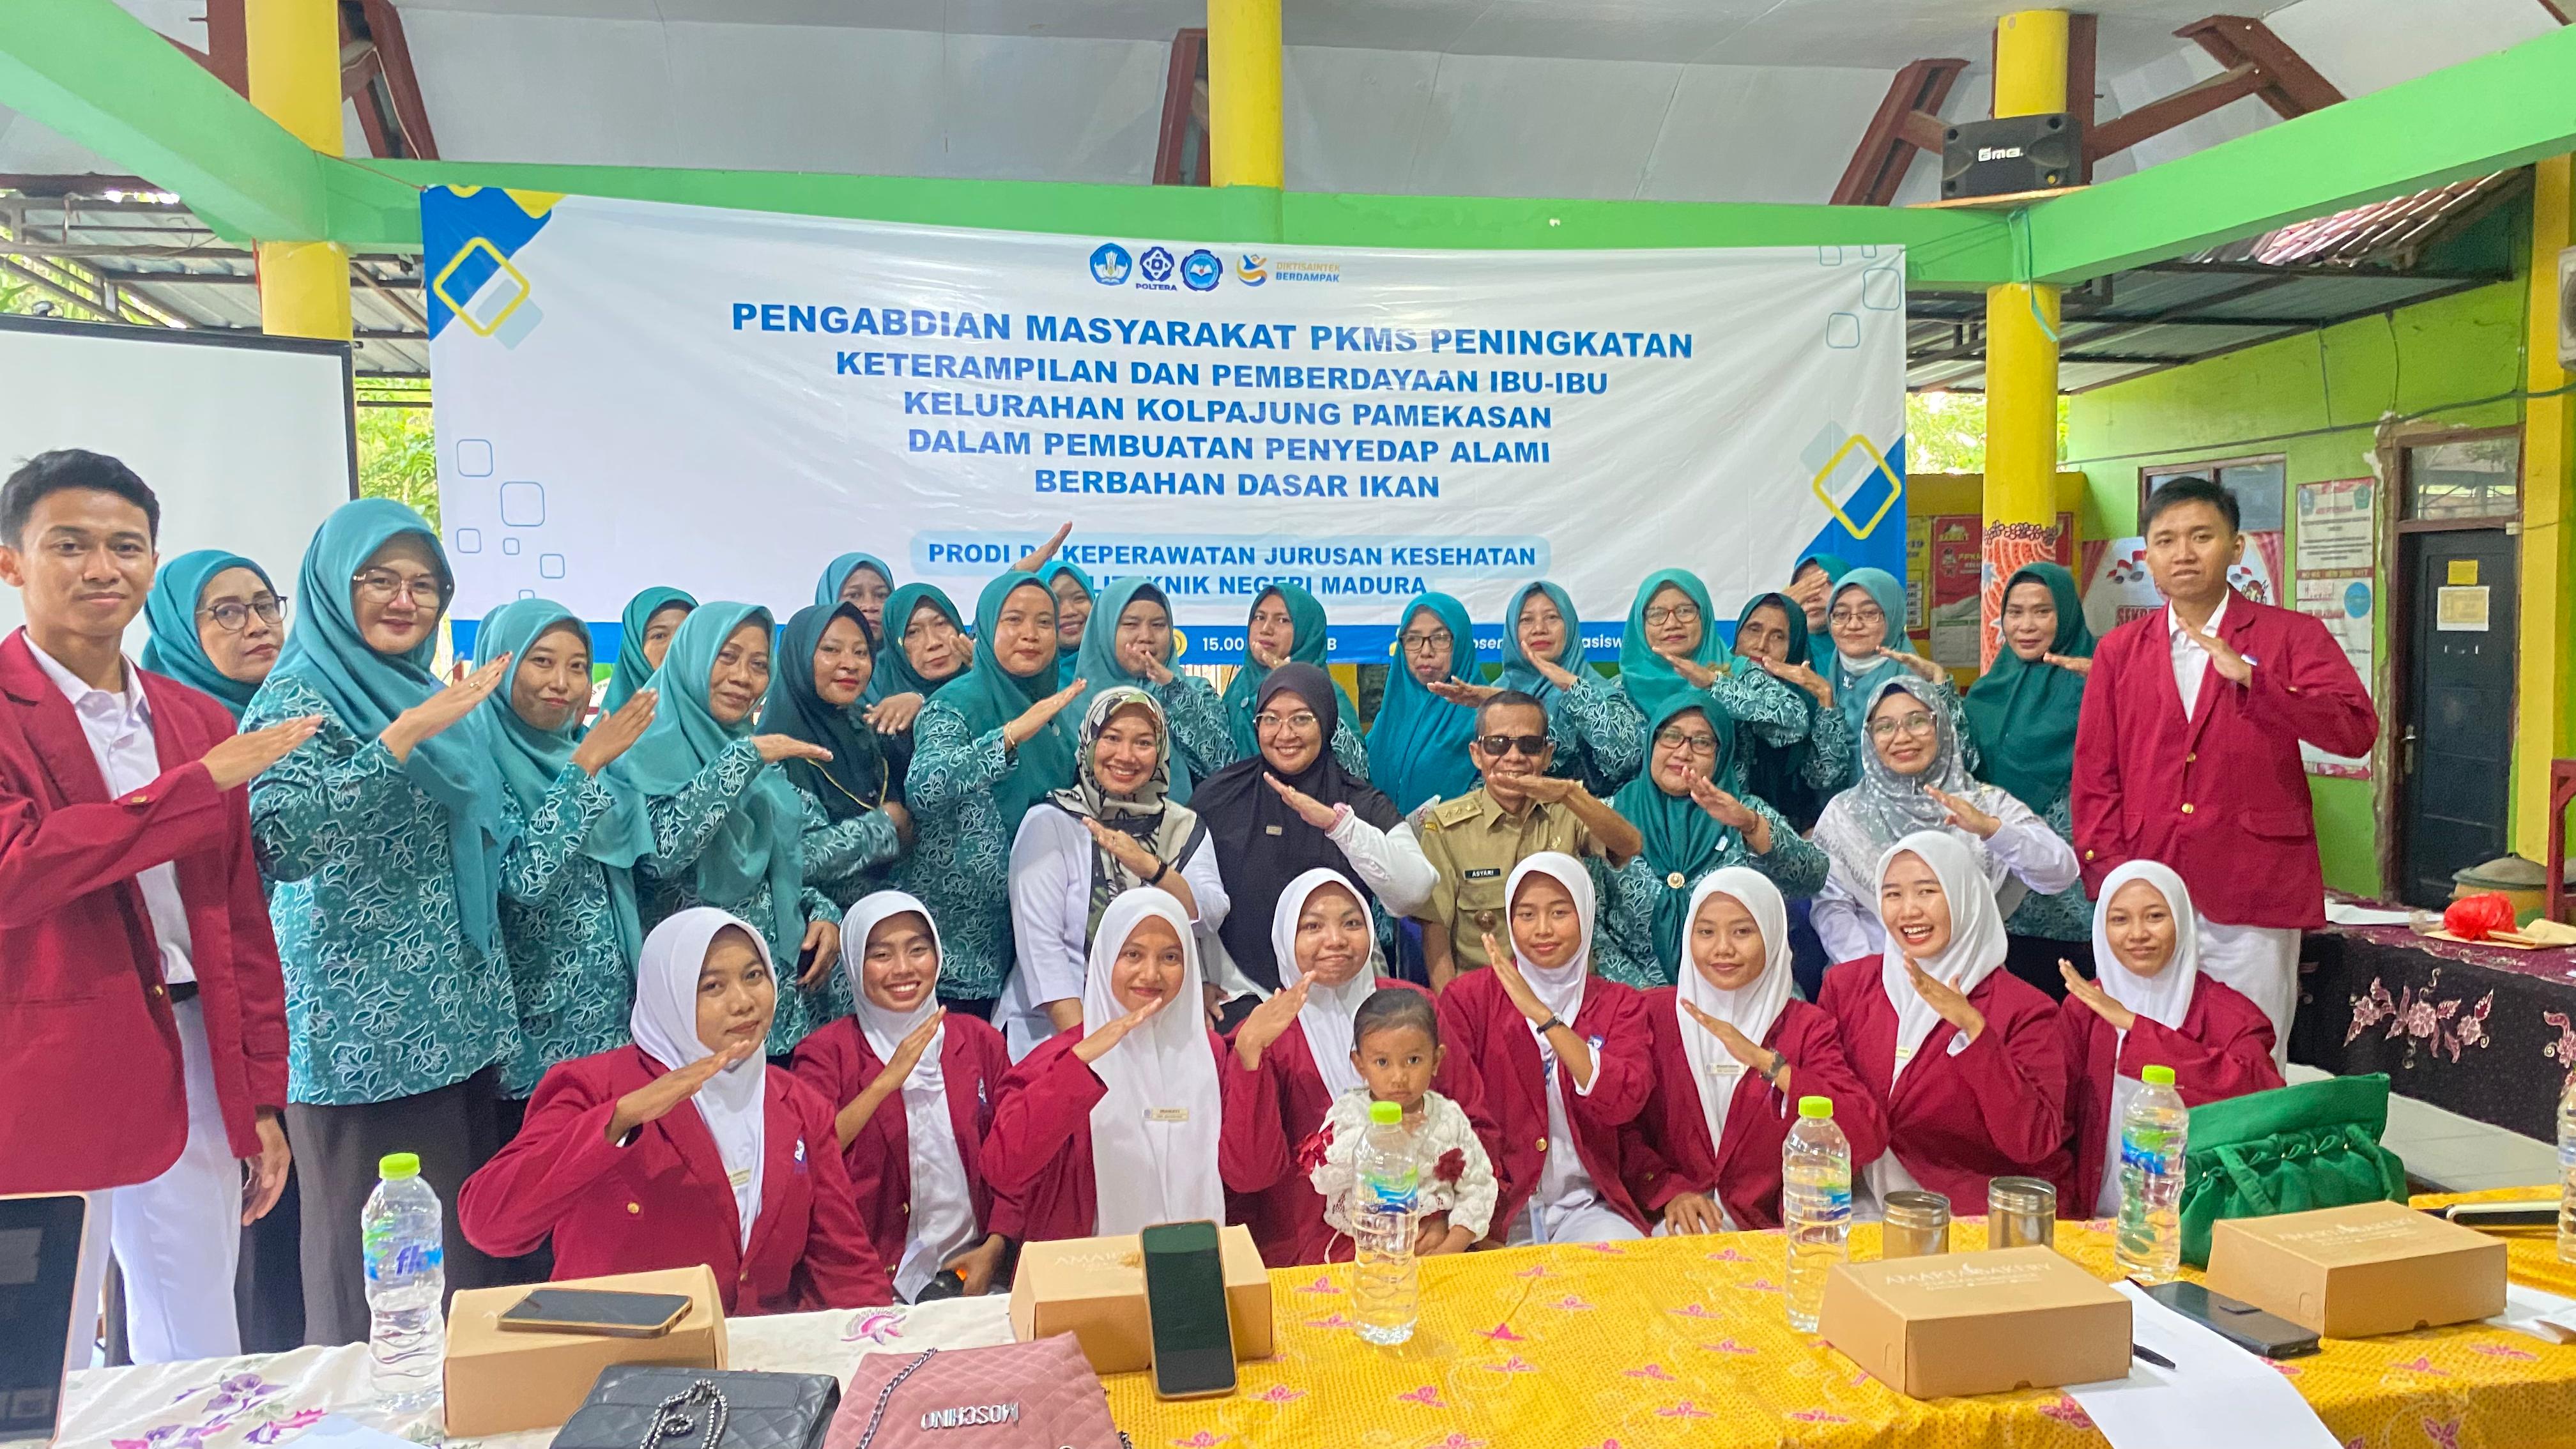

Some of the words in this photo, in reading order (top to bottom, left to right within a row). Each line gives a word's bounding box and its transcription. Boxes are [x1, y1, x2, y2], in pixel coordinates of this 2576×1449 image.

[1276, 261, 1340, 272] DIKTISAINTEK
[1276, 272, 1340, 283] BERDAMPAK
[1136, 283, 1177, 291] POLTERA
[732, 303, 1011, 340] PENGABDIAN
[1026, 314, 1296, 349] MASYARAKAT
[1311, 326, 1418, 352] PKMS
[1432, 329, 1692, 359] PENINGKATAN
[837, 351, 1117, 384] KETERAMPILAN
[1131, 362, 1199, 386] DAN
[1212, 364, 1478, 392] PEMBERDAYAAN
[1490, 371, 1607, 394] IBU-IBU
[905, 392, 1124, 420] KELURAHAN
[1137, 399, 1340, 425] KOLPAJUNG
[1353, 404, 1551, 428] PAMEKASAN
[908, 429, 1030, 455] DALAM
[1045, 434, 1254, 460] PEMBUATAN
[1266, 438, 1439, 463] PENYEDAP
[1451, 442, 1550, 463] ALAMI
[1035, 470, 1225, 495] BERBAHAN
[1238, 473, 1347, 497] DASAR
[1361, 476, 1439, 498] IKAN
[929, 544, 1009, 563] PRODI
[1062, 545, 1255, 565] KEPERAWATAN
[1264, 548, 1382, 565] JURUSAN
[1392, 548, 1535, 566] KESEHATAN
[1322, 577, 1425, 595] MADURA
[921, 1400, 1019, 1430] MOSCHINO
